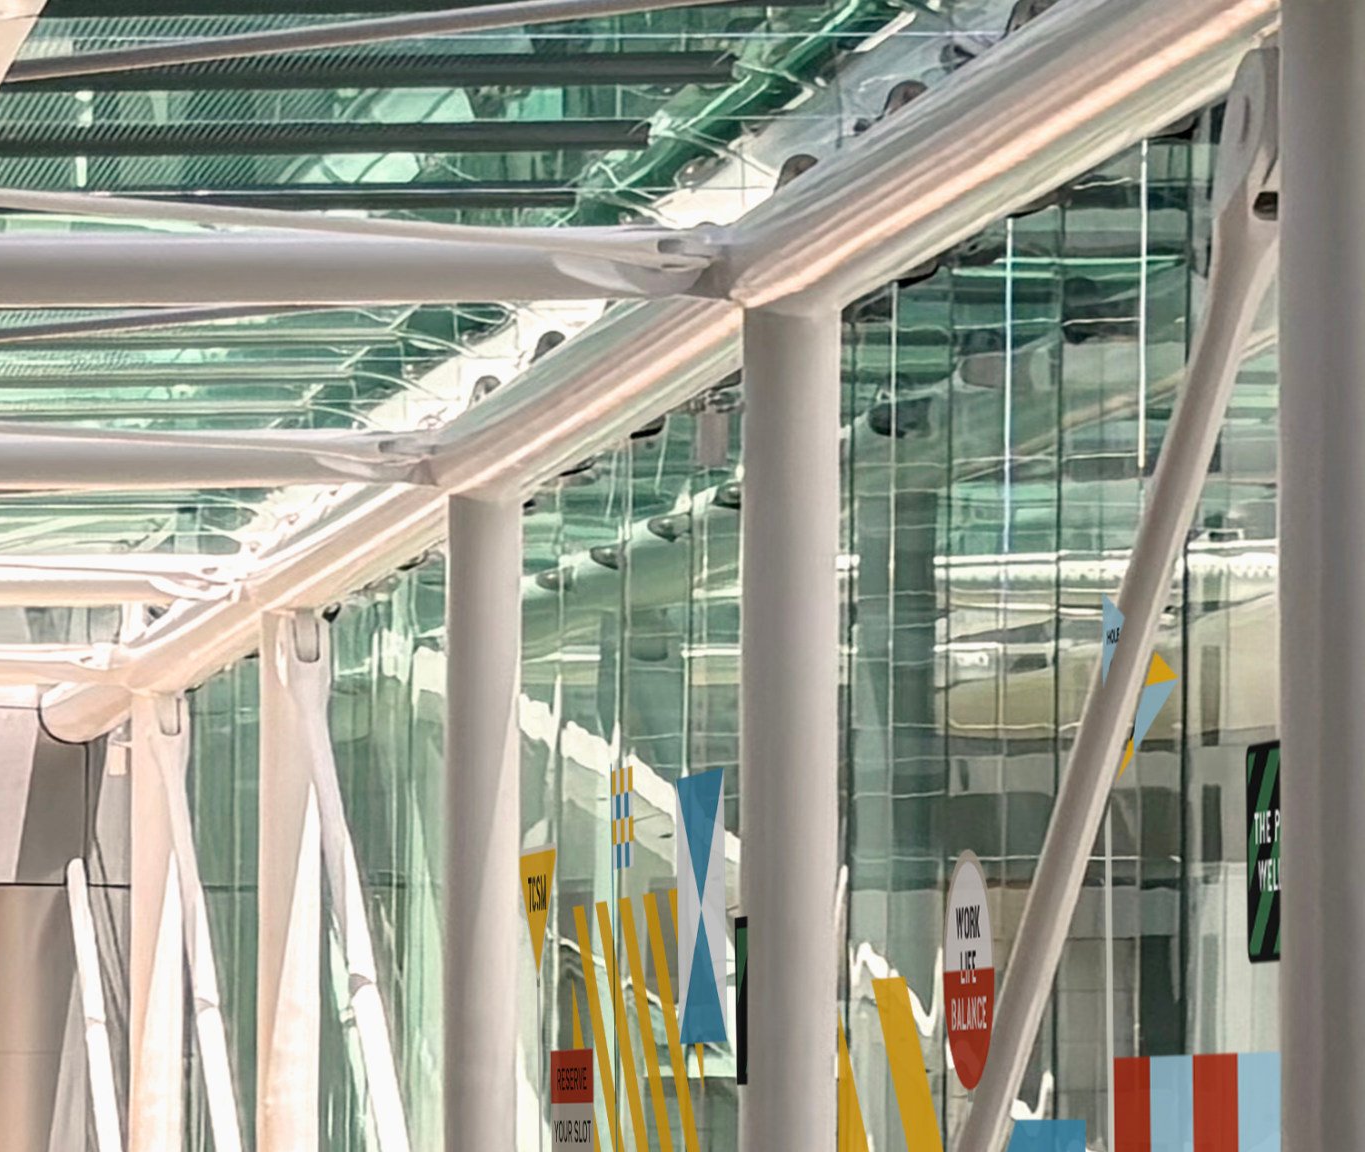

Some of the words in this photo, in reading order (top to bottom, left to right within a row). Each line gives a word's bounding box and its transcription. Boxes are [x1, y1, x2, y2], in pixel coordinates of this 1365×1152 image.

[1254, 810, 1271, 845] THE
[955, 905, 981, 940] WORK
[960, 950, 976, 985] LIFE
[951, 996, 987, 1032] BALANCE
[557, 1068, 588, 1091] RESERVE
[554, 1120, 573, 1143] YOUR
[574, 1120, 592, 1143] SLOT
